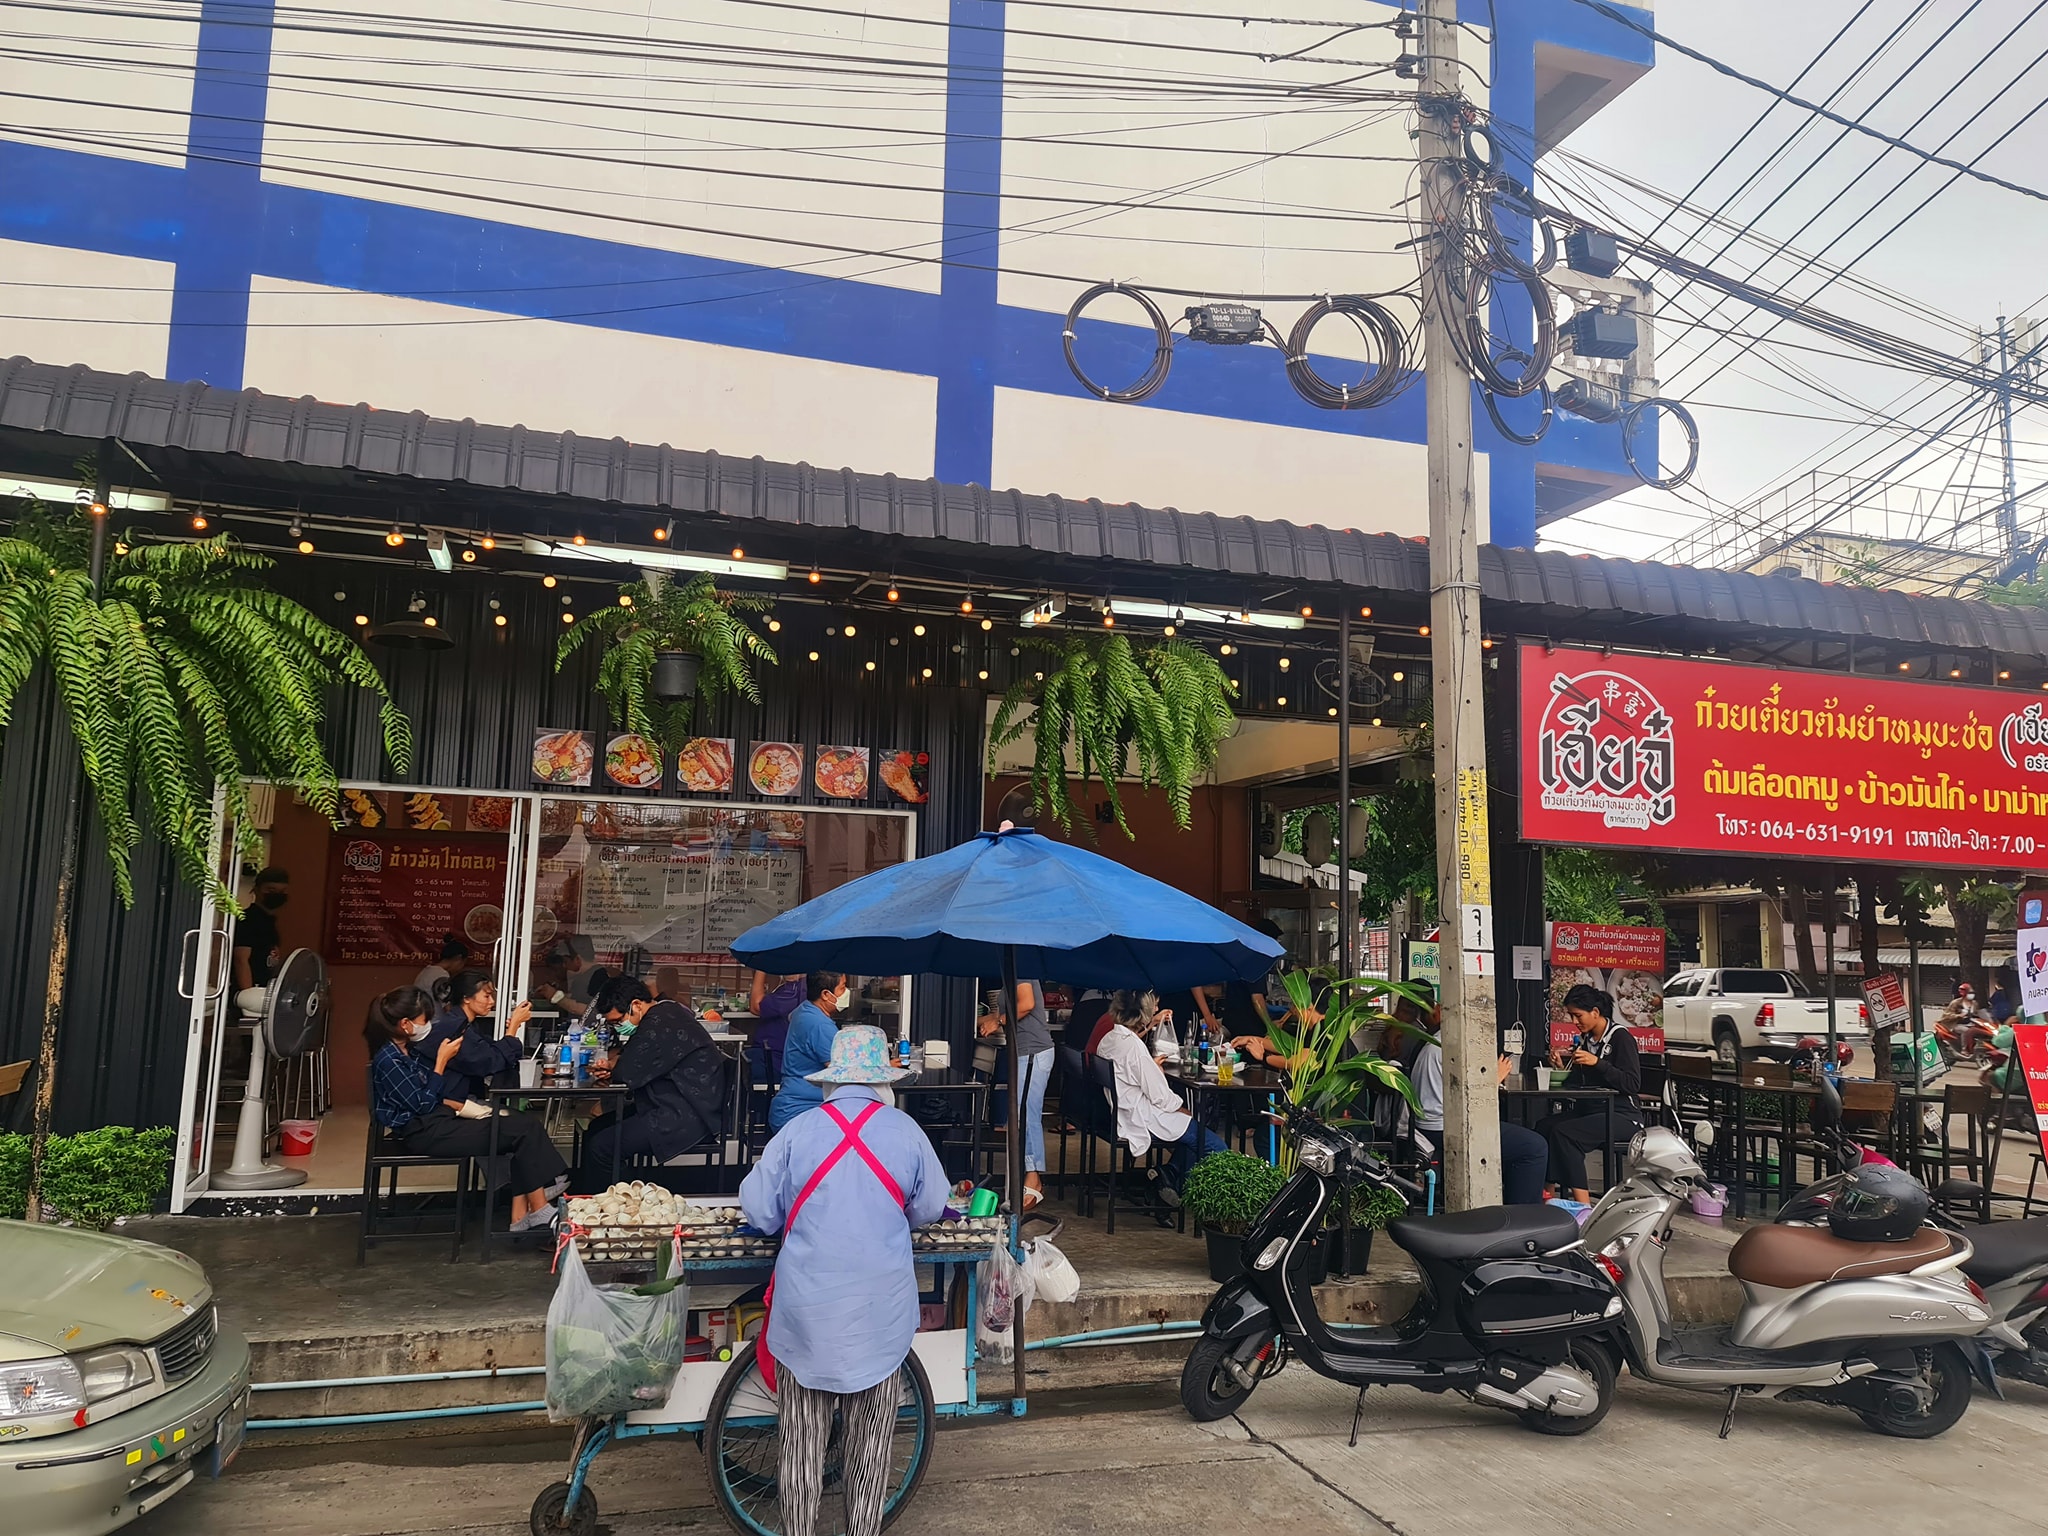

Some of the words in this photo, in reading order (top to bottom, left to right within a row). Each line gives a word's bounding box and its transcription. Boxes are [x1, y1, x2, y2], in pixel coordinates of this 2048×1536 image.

[1695, 682, 1993, 759] ก๋วยเตี๋ยวต้มยำหมูบะช่อ
[1540, 699, 1674, 824] เฮียจู๋
[1703, 758, 1838, 812] ต้มเลือดหมู
[1858, 770, 1965, 811] ข้าวมันไก่
[389, 846, 496, 871] ข้าวมันไก่ตอน
[1760, 820, 1893, 846] 064-631-9191
